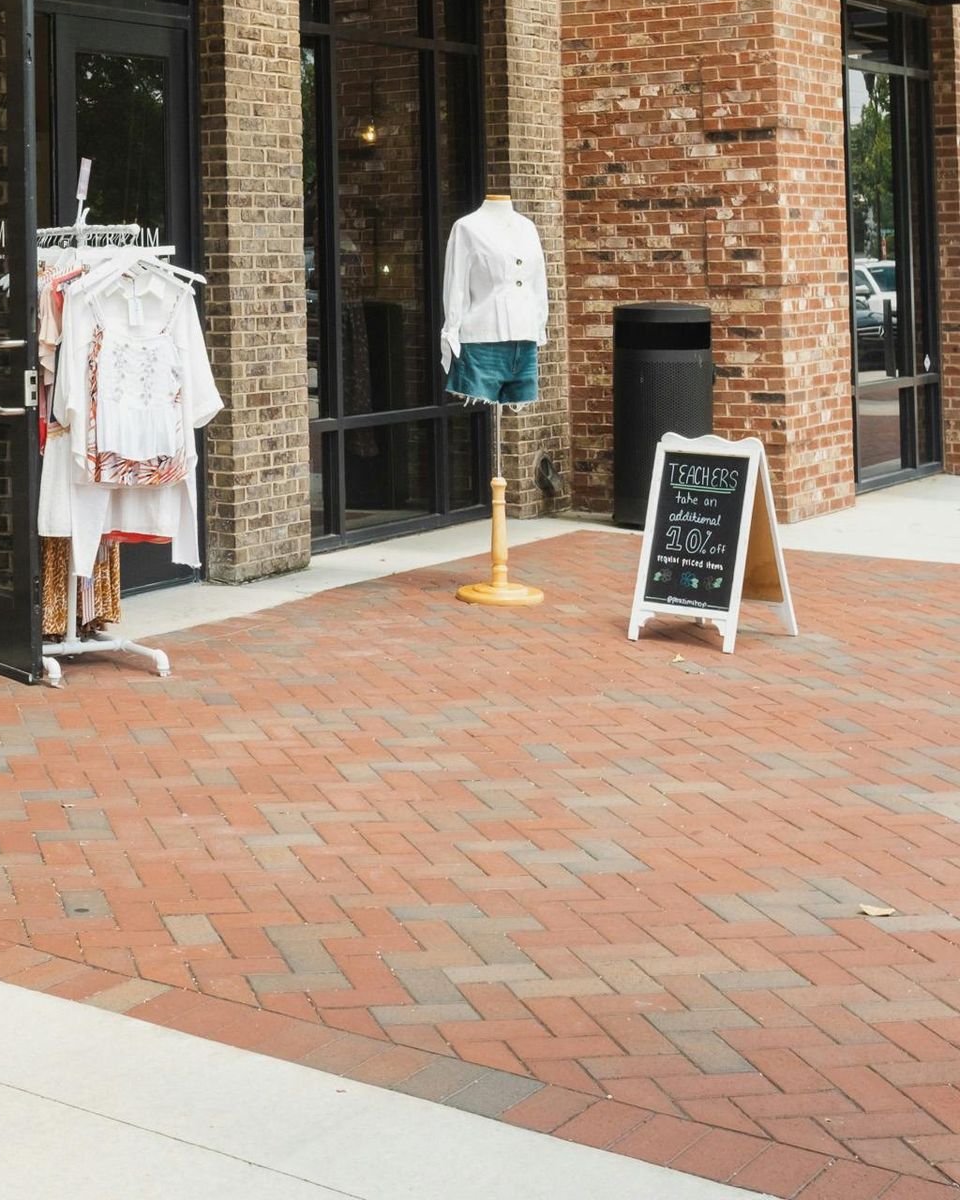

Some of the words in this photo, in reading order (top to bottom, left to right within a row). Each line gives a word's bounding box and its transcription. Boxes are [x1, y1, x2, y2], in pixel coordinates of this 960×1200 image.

[669, 463, 739, 489] TEACHERS
[676, 491, 698, 505] take
[704, 498, 717, 507] an
[669, 509, 721, 526] additional
[666, 525, 712, 554] 10%
[709, 544, 726, 554] off
[657, 555, 680, 564] regular
[682, 558, 703, 568] priced
[706, 561, 723, 571] items
